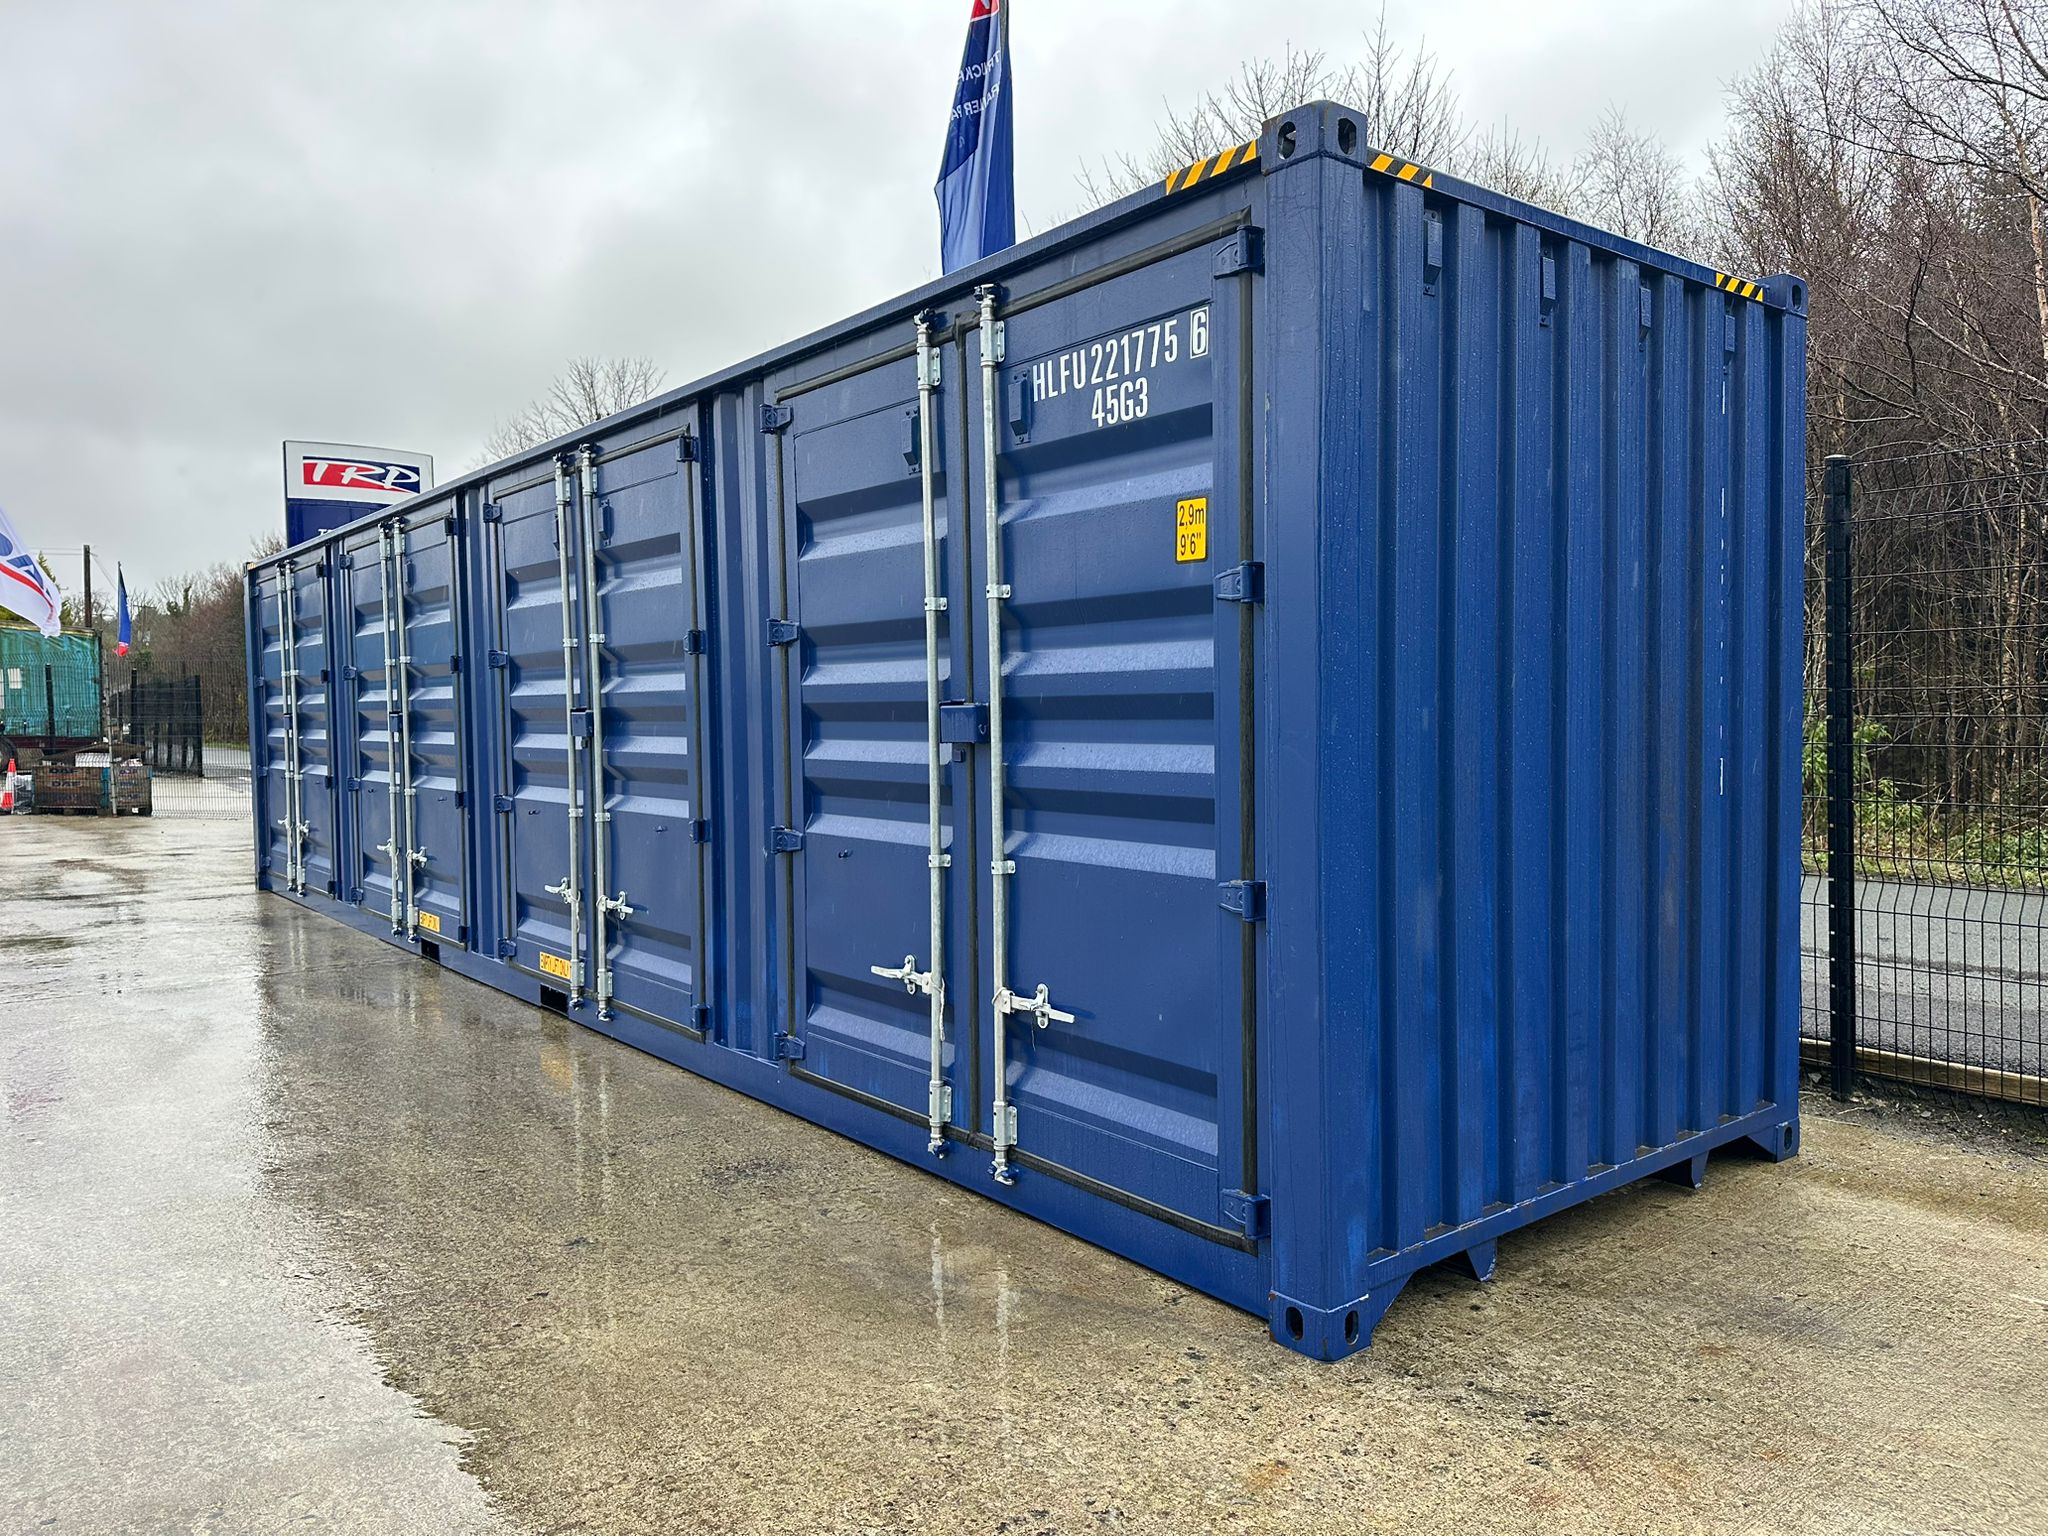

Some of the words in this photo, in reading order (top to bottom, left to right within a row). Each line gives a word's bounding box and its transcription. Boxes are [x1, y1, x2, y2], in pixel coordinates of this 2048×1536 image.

[1192, 310, 1208, 356] 6
[1091, 377, 1148, 428] 45G3
[303, 458, 420, 493] TRP
